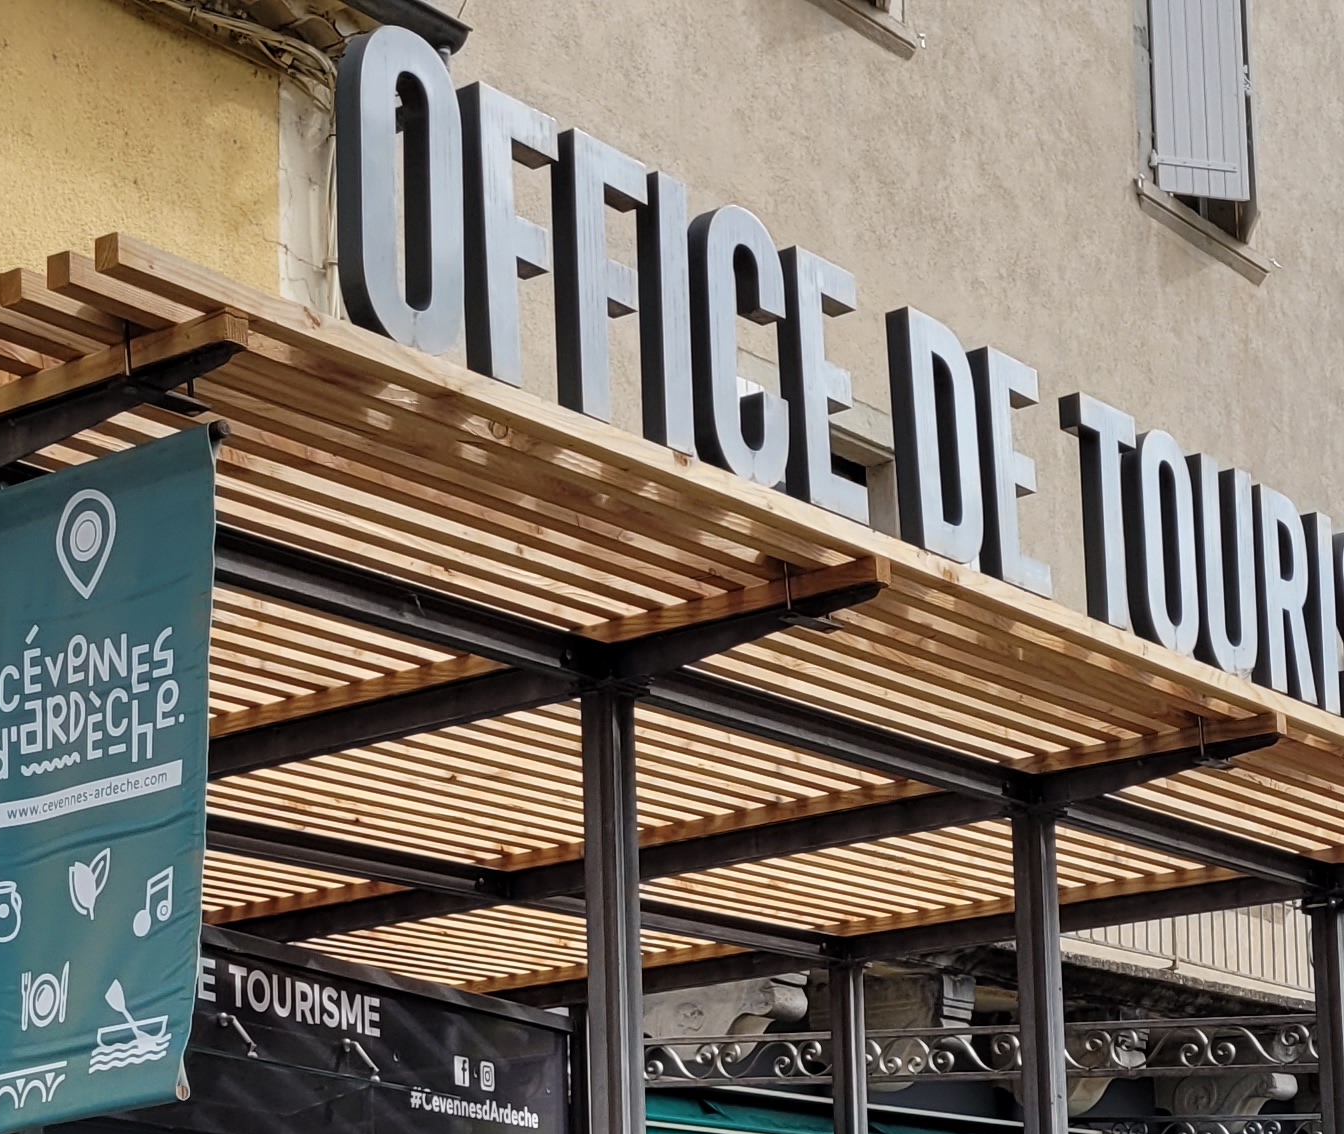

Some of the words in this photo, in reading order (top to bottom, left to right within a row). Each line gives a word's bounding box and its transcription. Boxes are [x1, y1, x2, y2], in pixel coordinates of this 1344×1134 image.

[335, 24, 869, 526] OFFICE
[886, 305, 1052, 598] DE
[6, 771, 168, 820] www.cevennes-ardeche.com
[197, 957, 216, 1002] E
[228, 964, 381, 1038] TOURISME
[410, 1086, 539, 1129] #CevennesdArdeche
